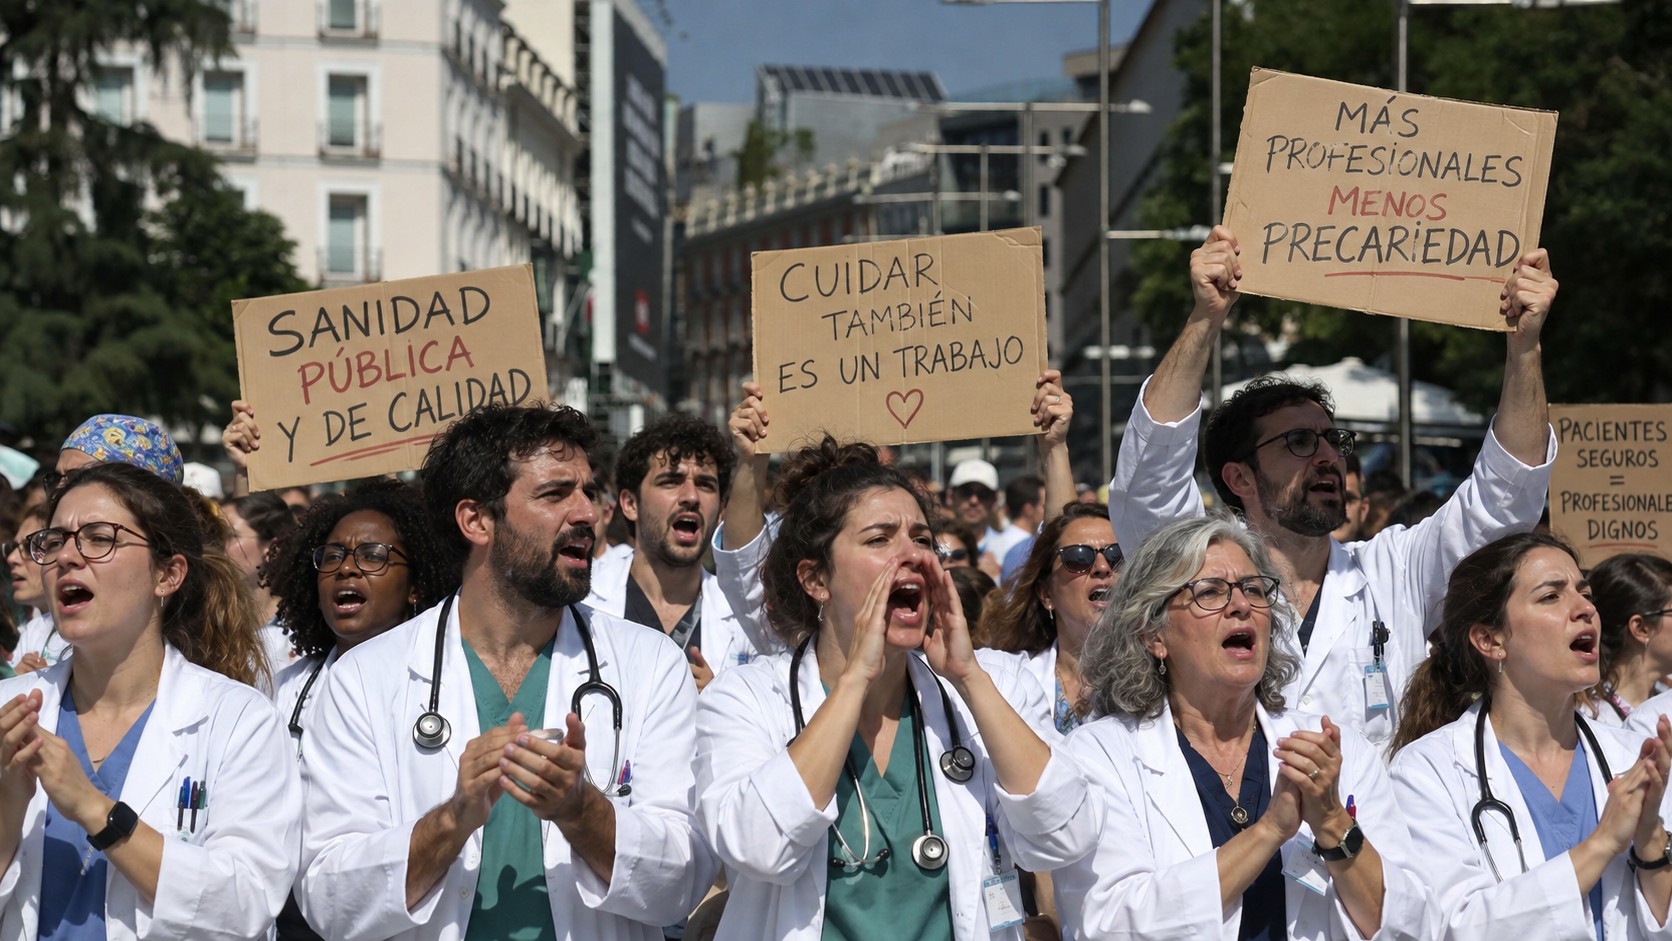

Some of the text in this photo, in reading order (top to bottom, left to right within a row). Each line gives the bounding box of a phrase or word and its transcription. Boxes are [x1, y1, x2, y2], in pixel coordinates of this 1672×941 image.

[1335, 95, 1419, 138] MÁS
[1327, 185, 1448, 221] MENOS
[268, 286, 490, 357] SANIDAD
[821, 290, 973, 341] TAMBIÉN
[778, 335, 1024, 393] ES UN TRABAJO
[277, 368, 532, 463] Y DE CALIDAD
[1577, 448, 1659, 468] SEGUROS
[1587, 518, 1659, 541] DIGNOS
